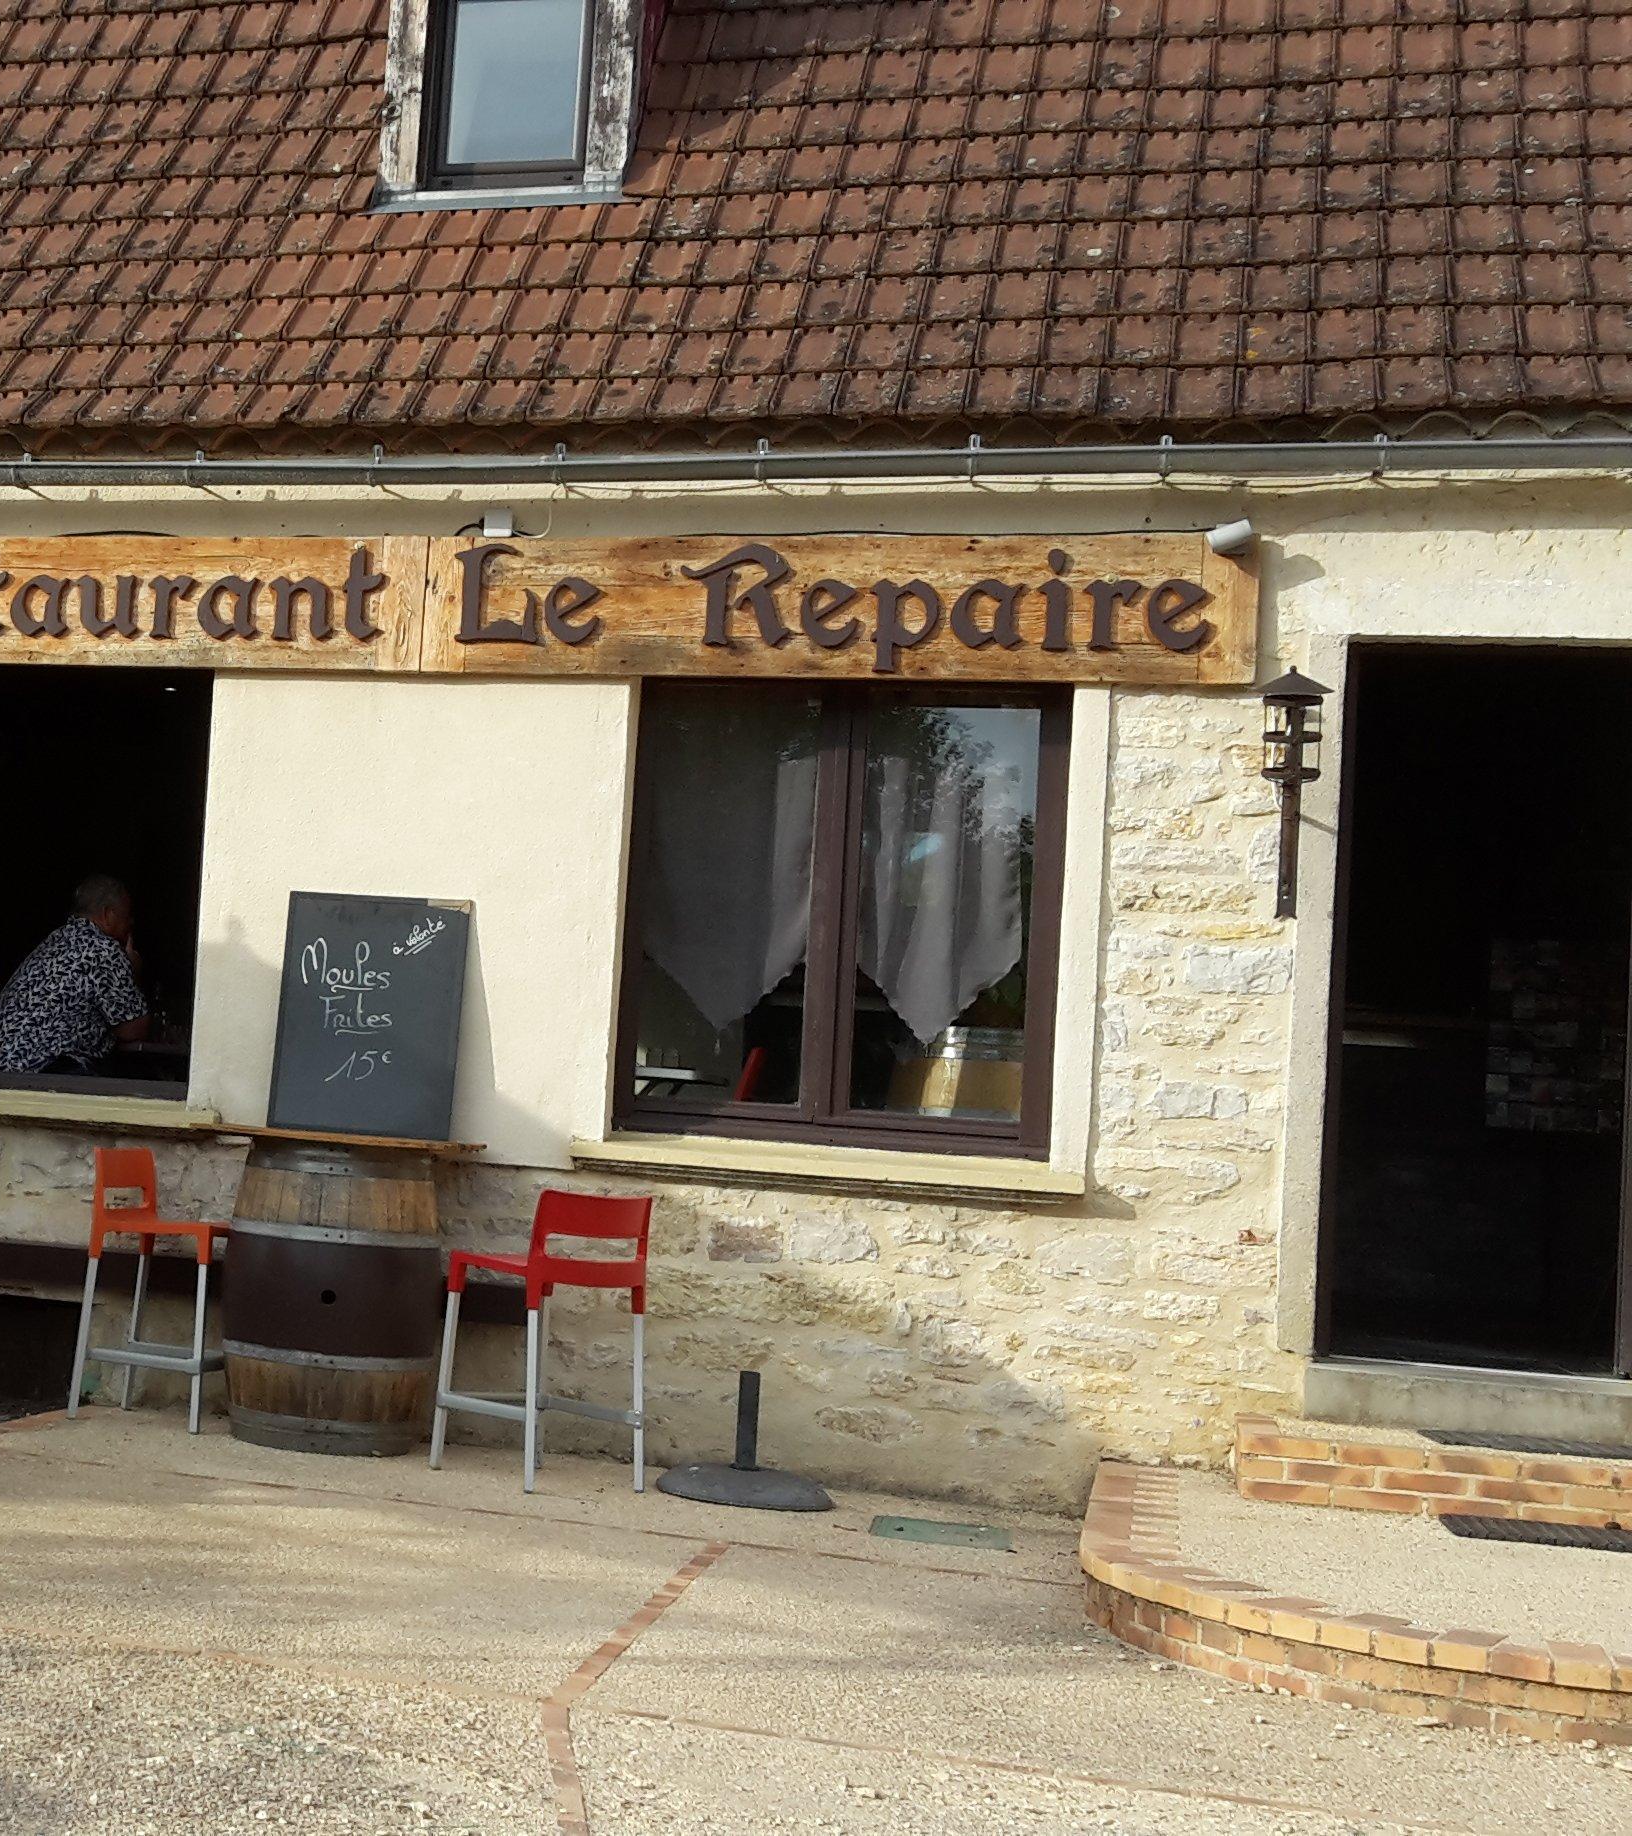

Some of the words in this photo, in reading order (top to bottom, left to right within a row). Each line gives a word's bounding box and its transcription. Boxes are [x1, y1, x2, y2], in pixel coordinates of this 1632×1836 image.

[454, 543, 607, 646] Le
[680, 543, 1216, 673] Repaire
[301, 936, 392, 989] Moules
[318, 992, 393, 1029] Frites
